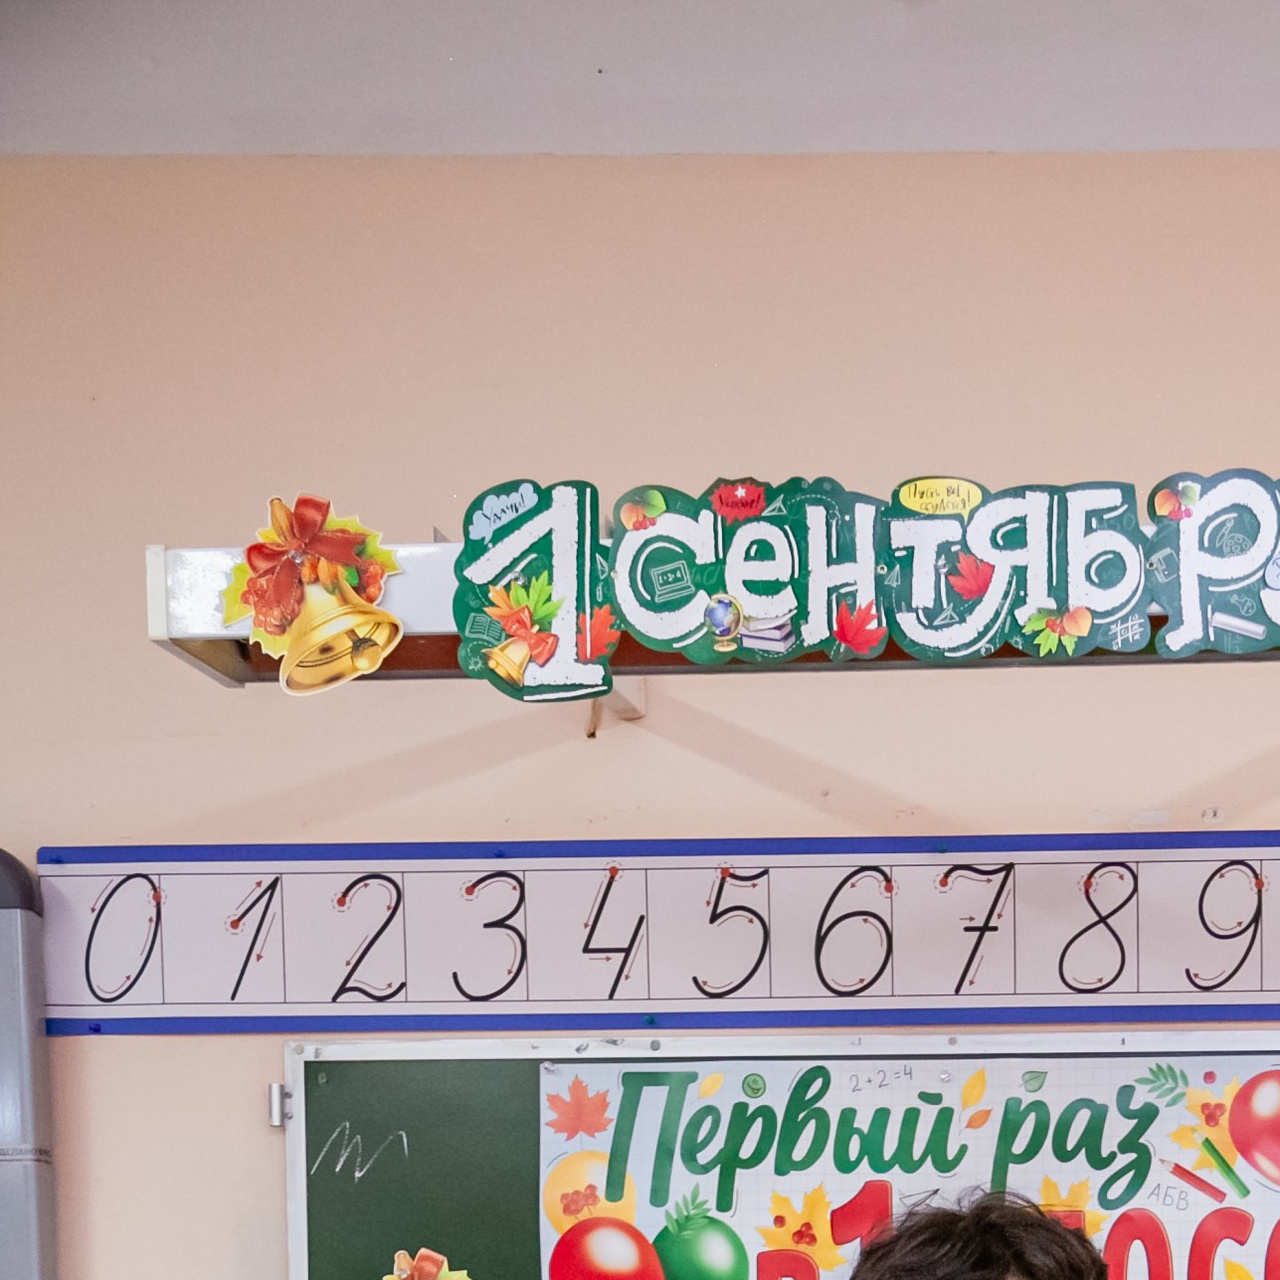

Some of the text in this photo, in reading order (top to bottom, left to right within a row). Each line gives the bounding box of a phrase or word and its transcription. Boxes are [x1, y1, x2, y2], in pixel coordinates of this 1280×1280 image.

[86, 874, 161, 1002] 0
[230, 876, 281, 1001] 1
[331, 873, 407, 1003] 2
[452, 870, 526, 1002] 3
[582, 873, 645, 1001] 4
[692, 868, 770, 999] 5
[814, 866, 893, 997] 6
[942, 862, 1016, 995] 7
[1058, 861, 1139, 994] 8
[1185, 859, 1262, 991] 9
[605, 1064, 1161, 1213] Первый раз
[1146, 1179, 1191, 1211] АБВ
